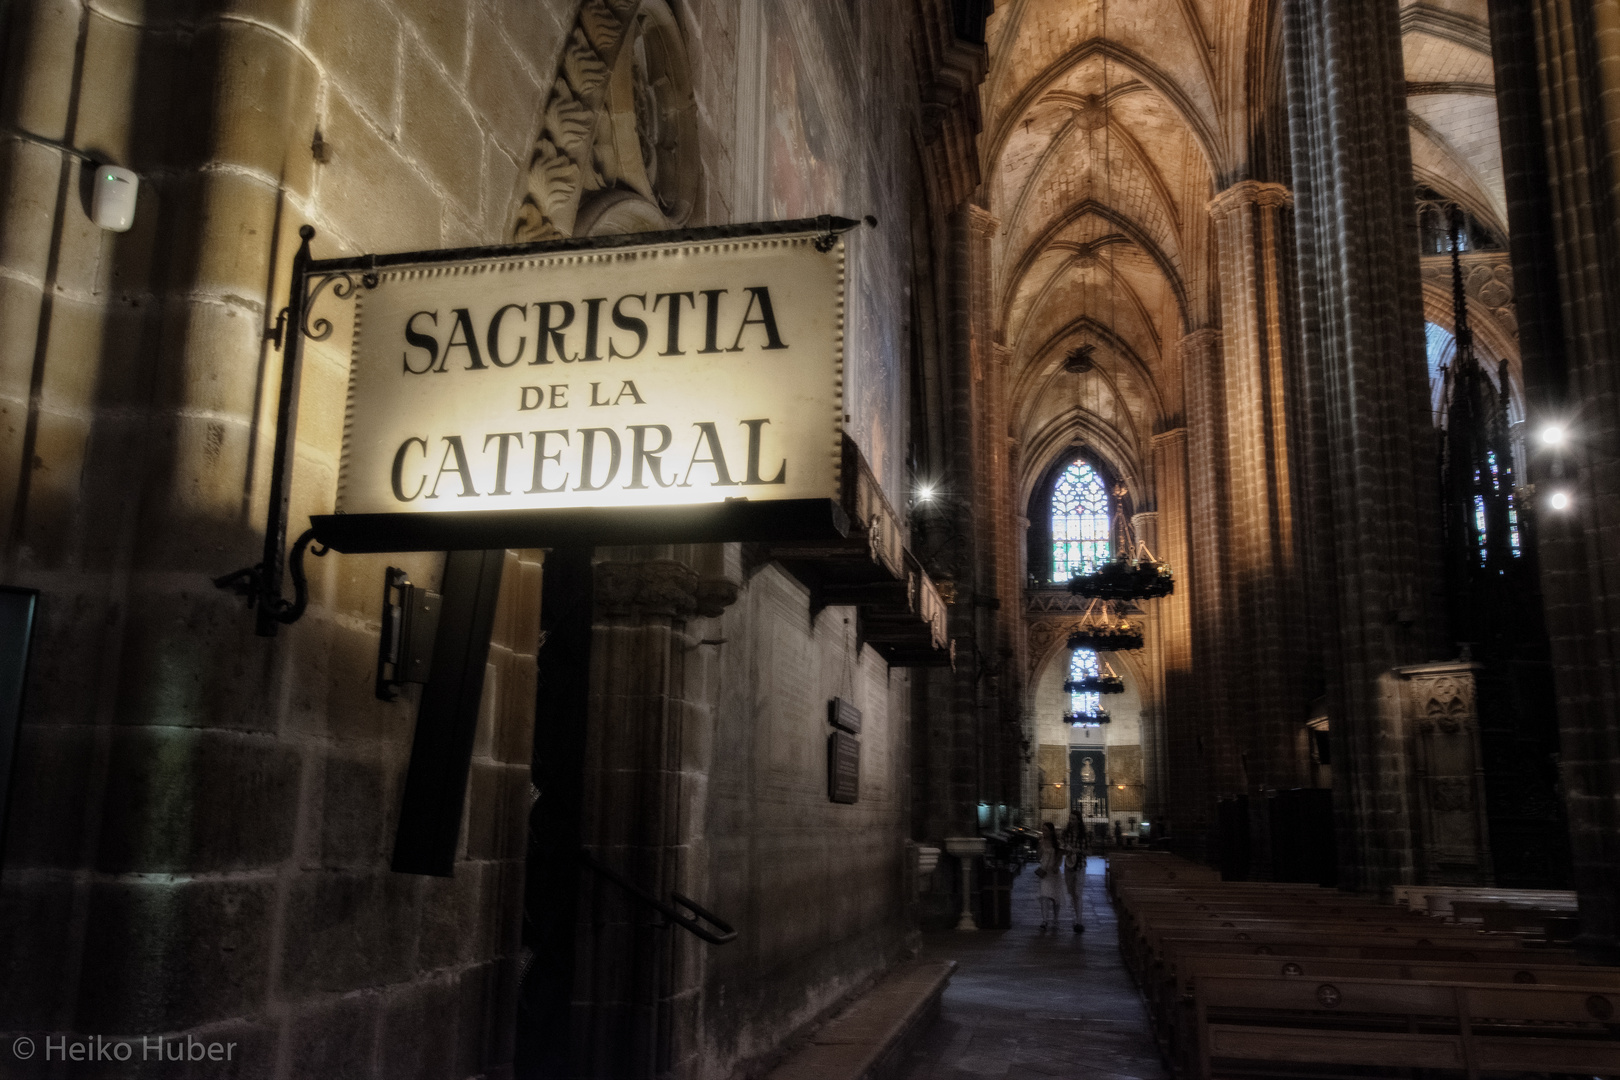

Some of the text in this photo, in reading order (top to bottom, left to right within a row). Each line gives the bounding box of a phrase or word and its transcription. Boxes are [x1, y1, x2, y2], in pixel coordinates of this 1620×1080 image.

[404, 287, 789, 376] SACRISTIA
[518, 380, 647, 411] DE LA
[391, 418, 787, 502] CATEDRAL
